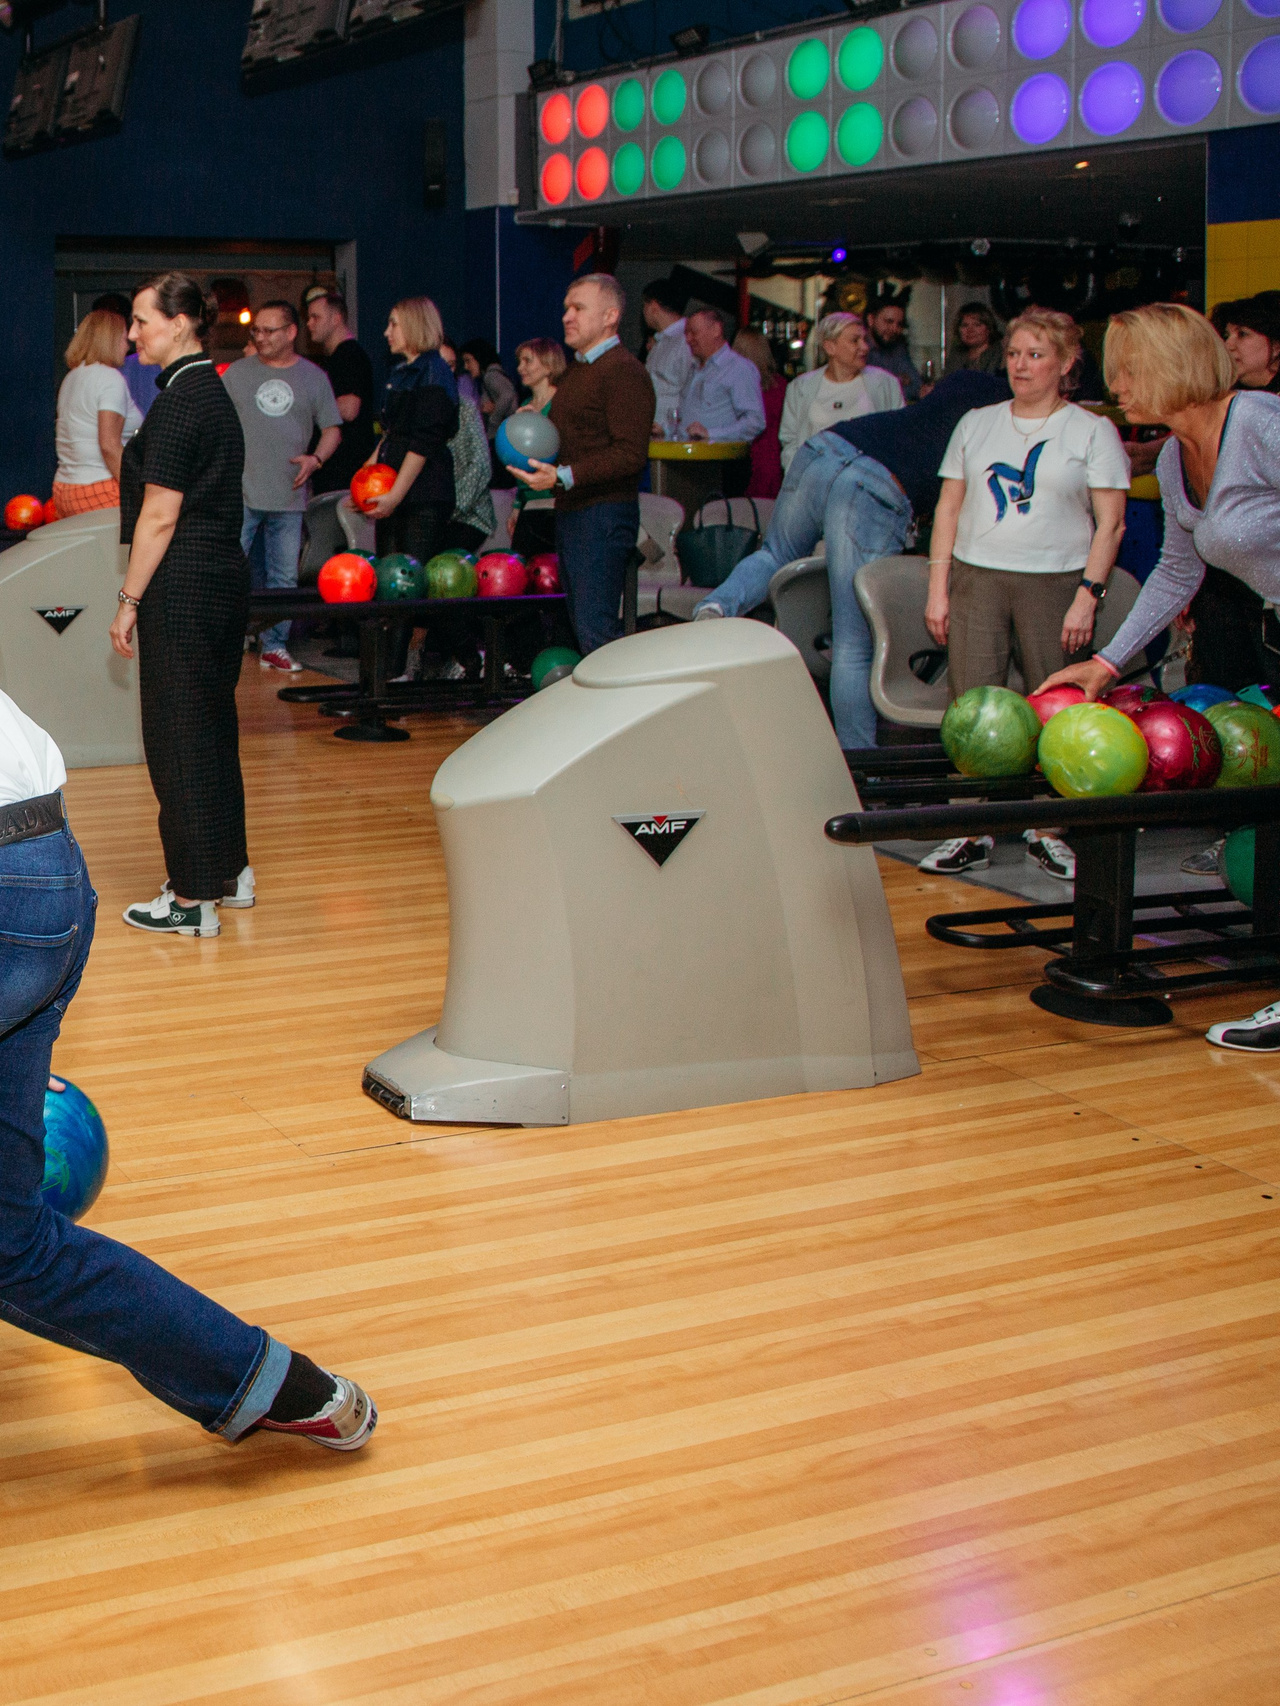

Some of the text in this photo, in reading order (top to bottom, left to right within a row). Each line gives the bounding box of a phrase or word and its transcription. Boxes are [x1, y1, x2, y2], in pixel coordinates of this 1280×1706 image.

[43, 610, 77, 618] AMF
[634, 820, 687, 836] AMF
[354, 1398, 363, 1419] 43
